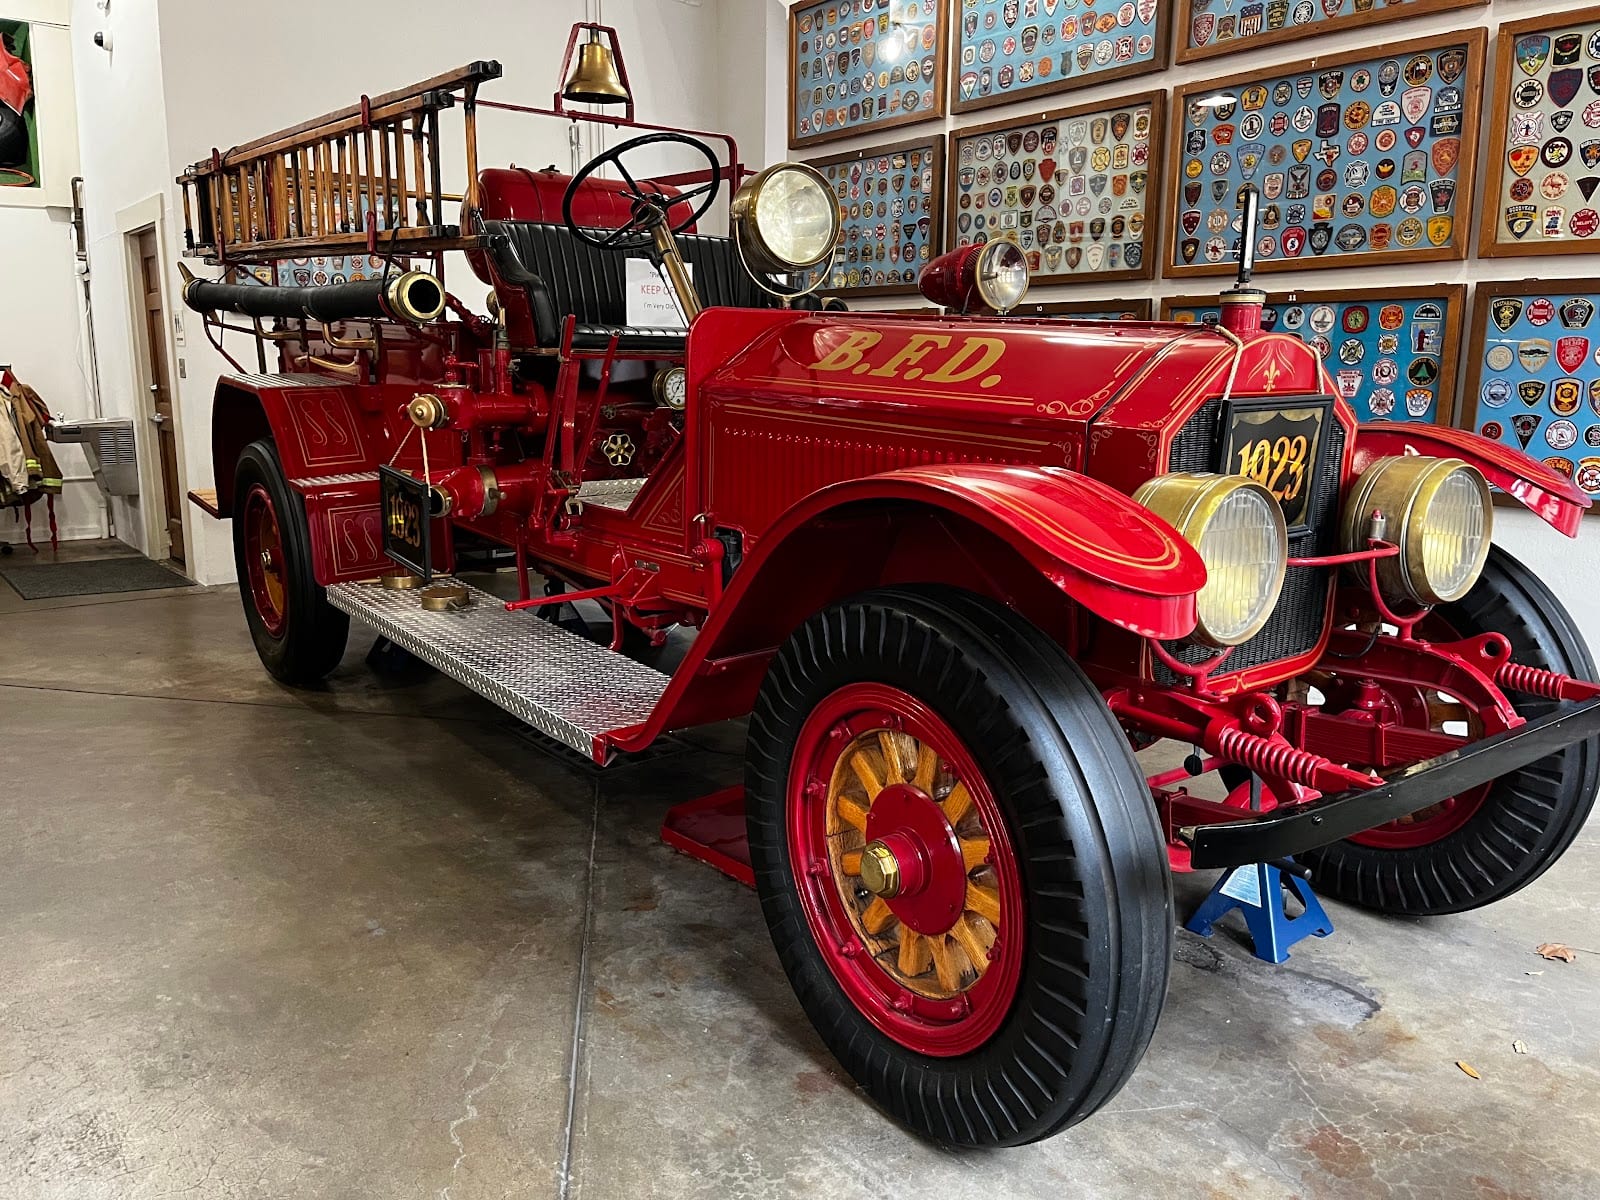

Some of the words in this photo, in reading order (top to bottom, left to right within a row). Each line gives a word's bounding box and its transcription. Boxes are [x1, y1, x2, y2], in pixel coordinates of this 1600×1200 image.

[640, 285, 661, 295] KEEP
[1494, 300, 1522, 308] EASTHAMPTON
[807, 331, 1006, 388] B.F.D.
[1238, 435, 1307, 502] 1923
[390, 493, 421, 547] 1923
